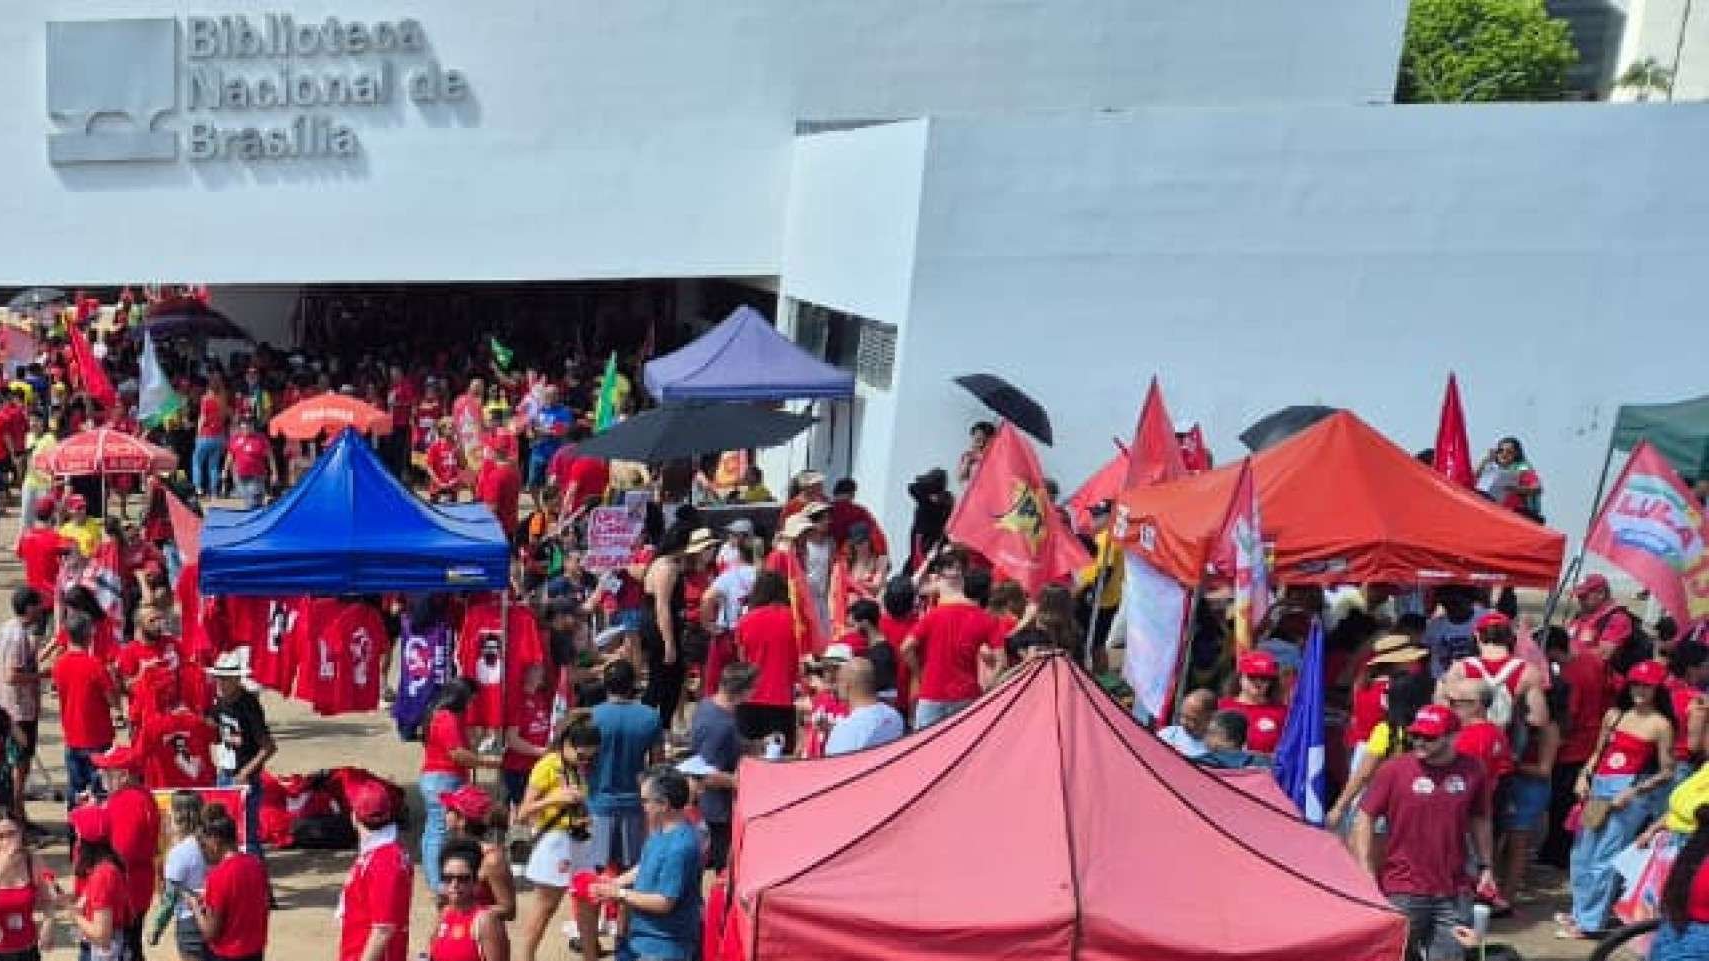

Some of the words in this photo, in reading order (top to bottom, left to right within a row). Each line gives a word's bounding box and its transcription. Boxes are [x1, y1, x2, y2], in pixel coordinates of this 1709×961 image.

[190, 16, 425, 58] Biblioteca
[190, 66, 390, 109] Nacional
[407, 64, 469, 104] de
[190, 116, 358, 160] Brasília
